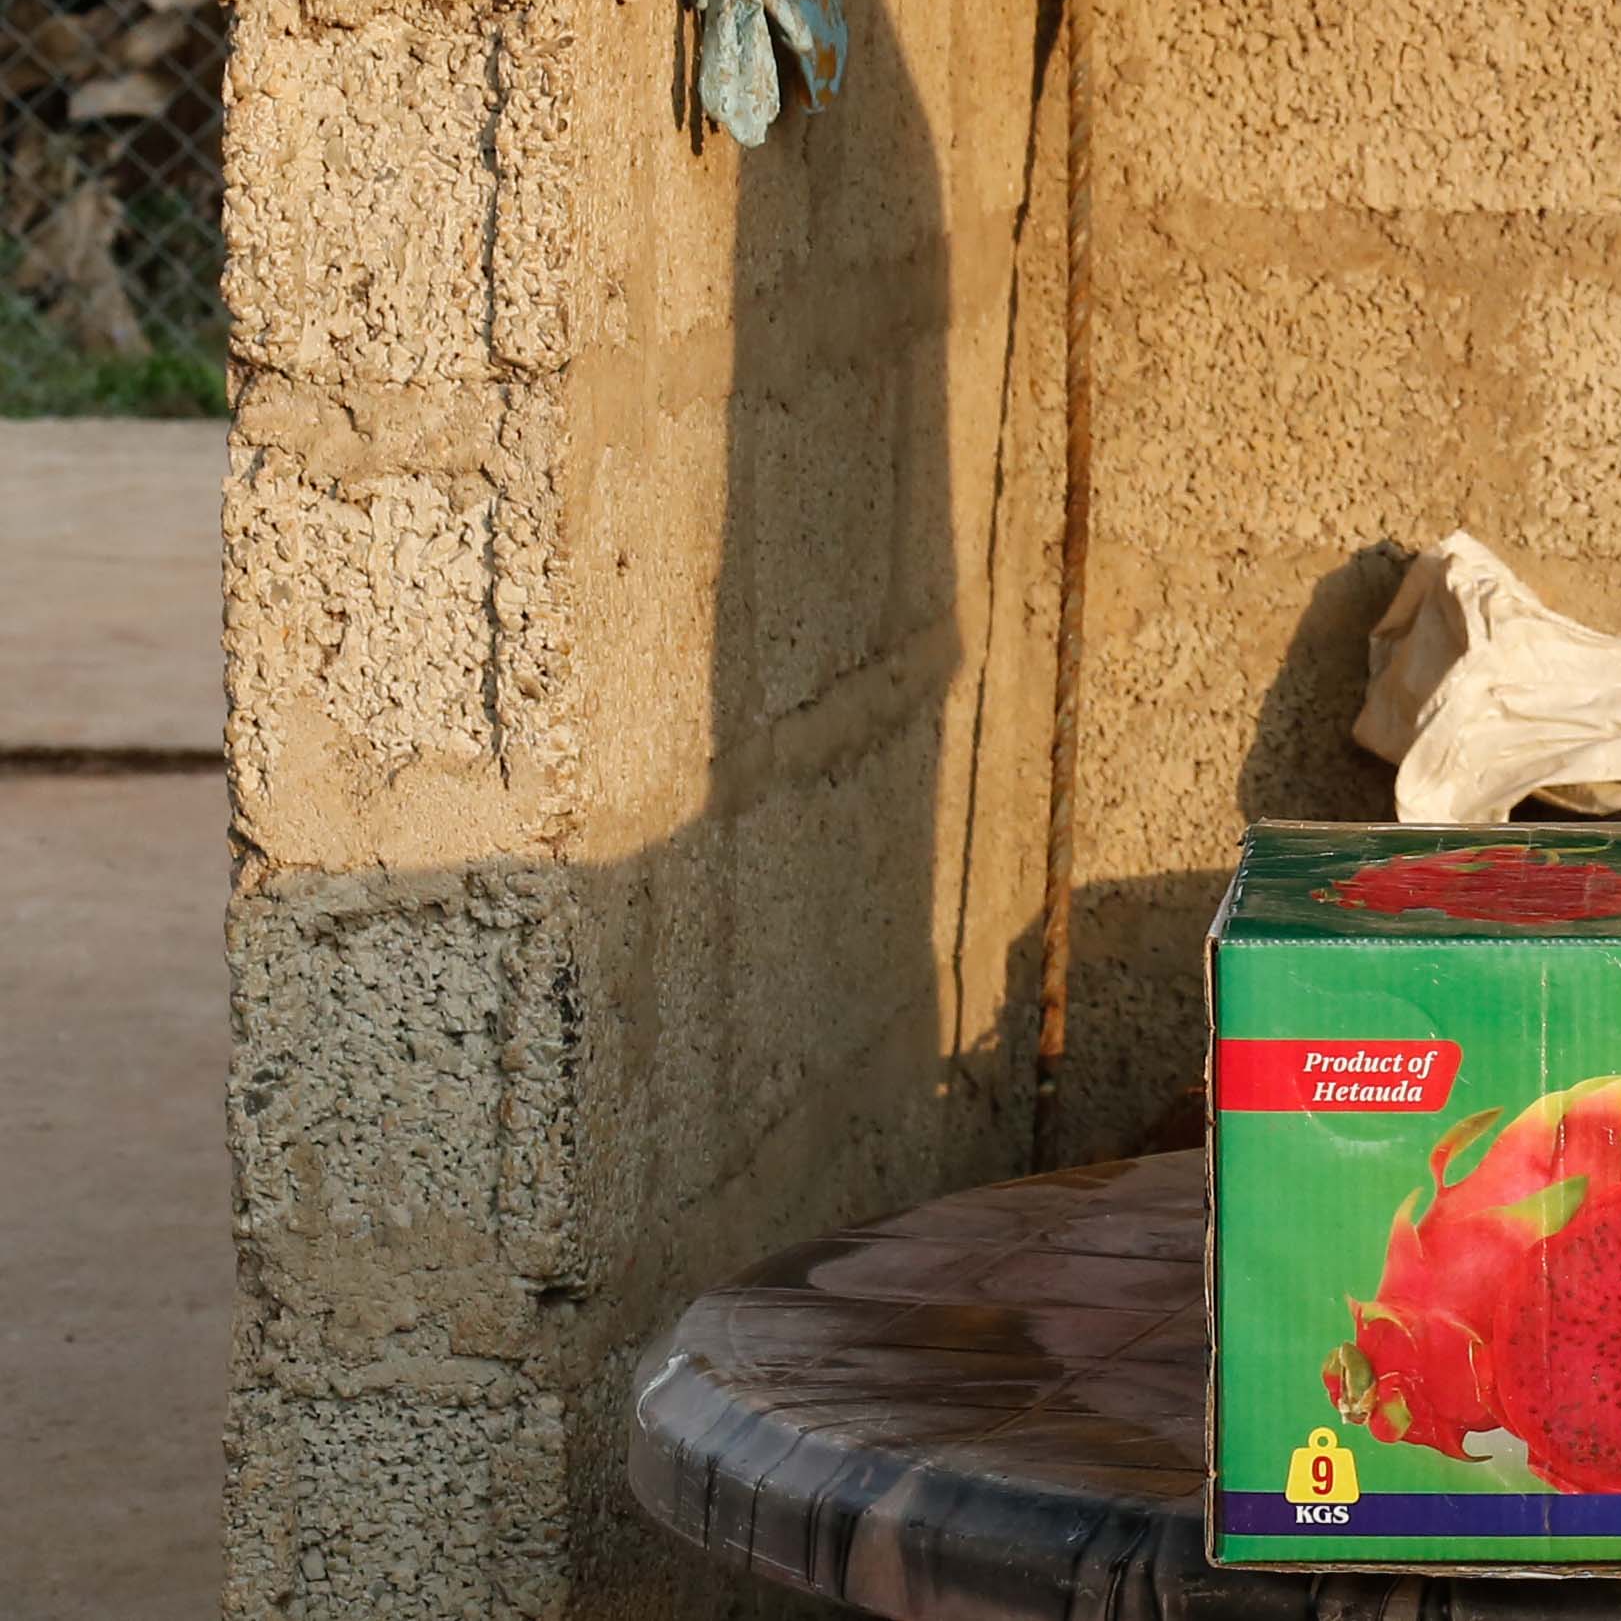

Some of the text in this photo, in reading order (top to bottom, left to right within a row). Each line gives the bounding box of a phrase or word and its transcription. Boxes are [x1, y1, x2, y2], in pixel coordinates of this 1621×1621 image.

[1303, 1050, 1438, 1080] Product of
[1312, 1080, 1423, 1103] Hetauda
[1312, 1455, 1334, 1496] 9
[1295, 1505, 1350, 1524] KGS
